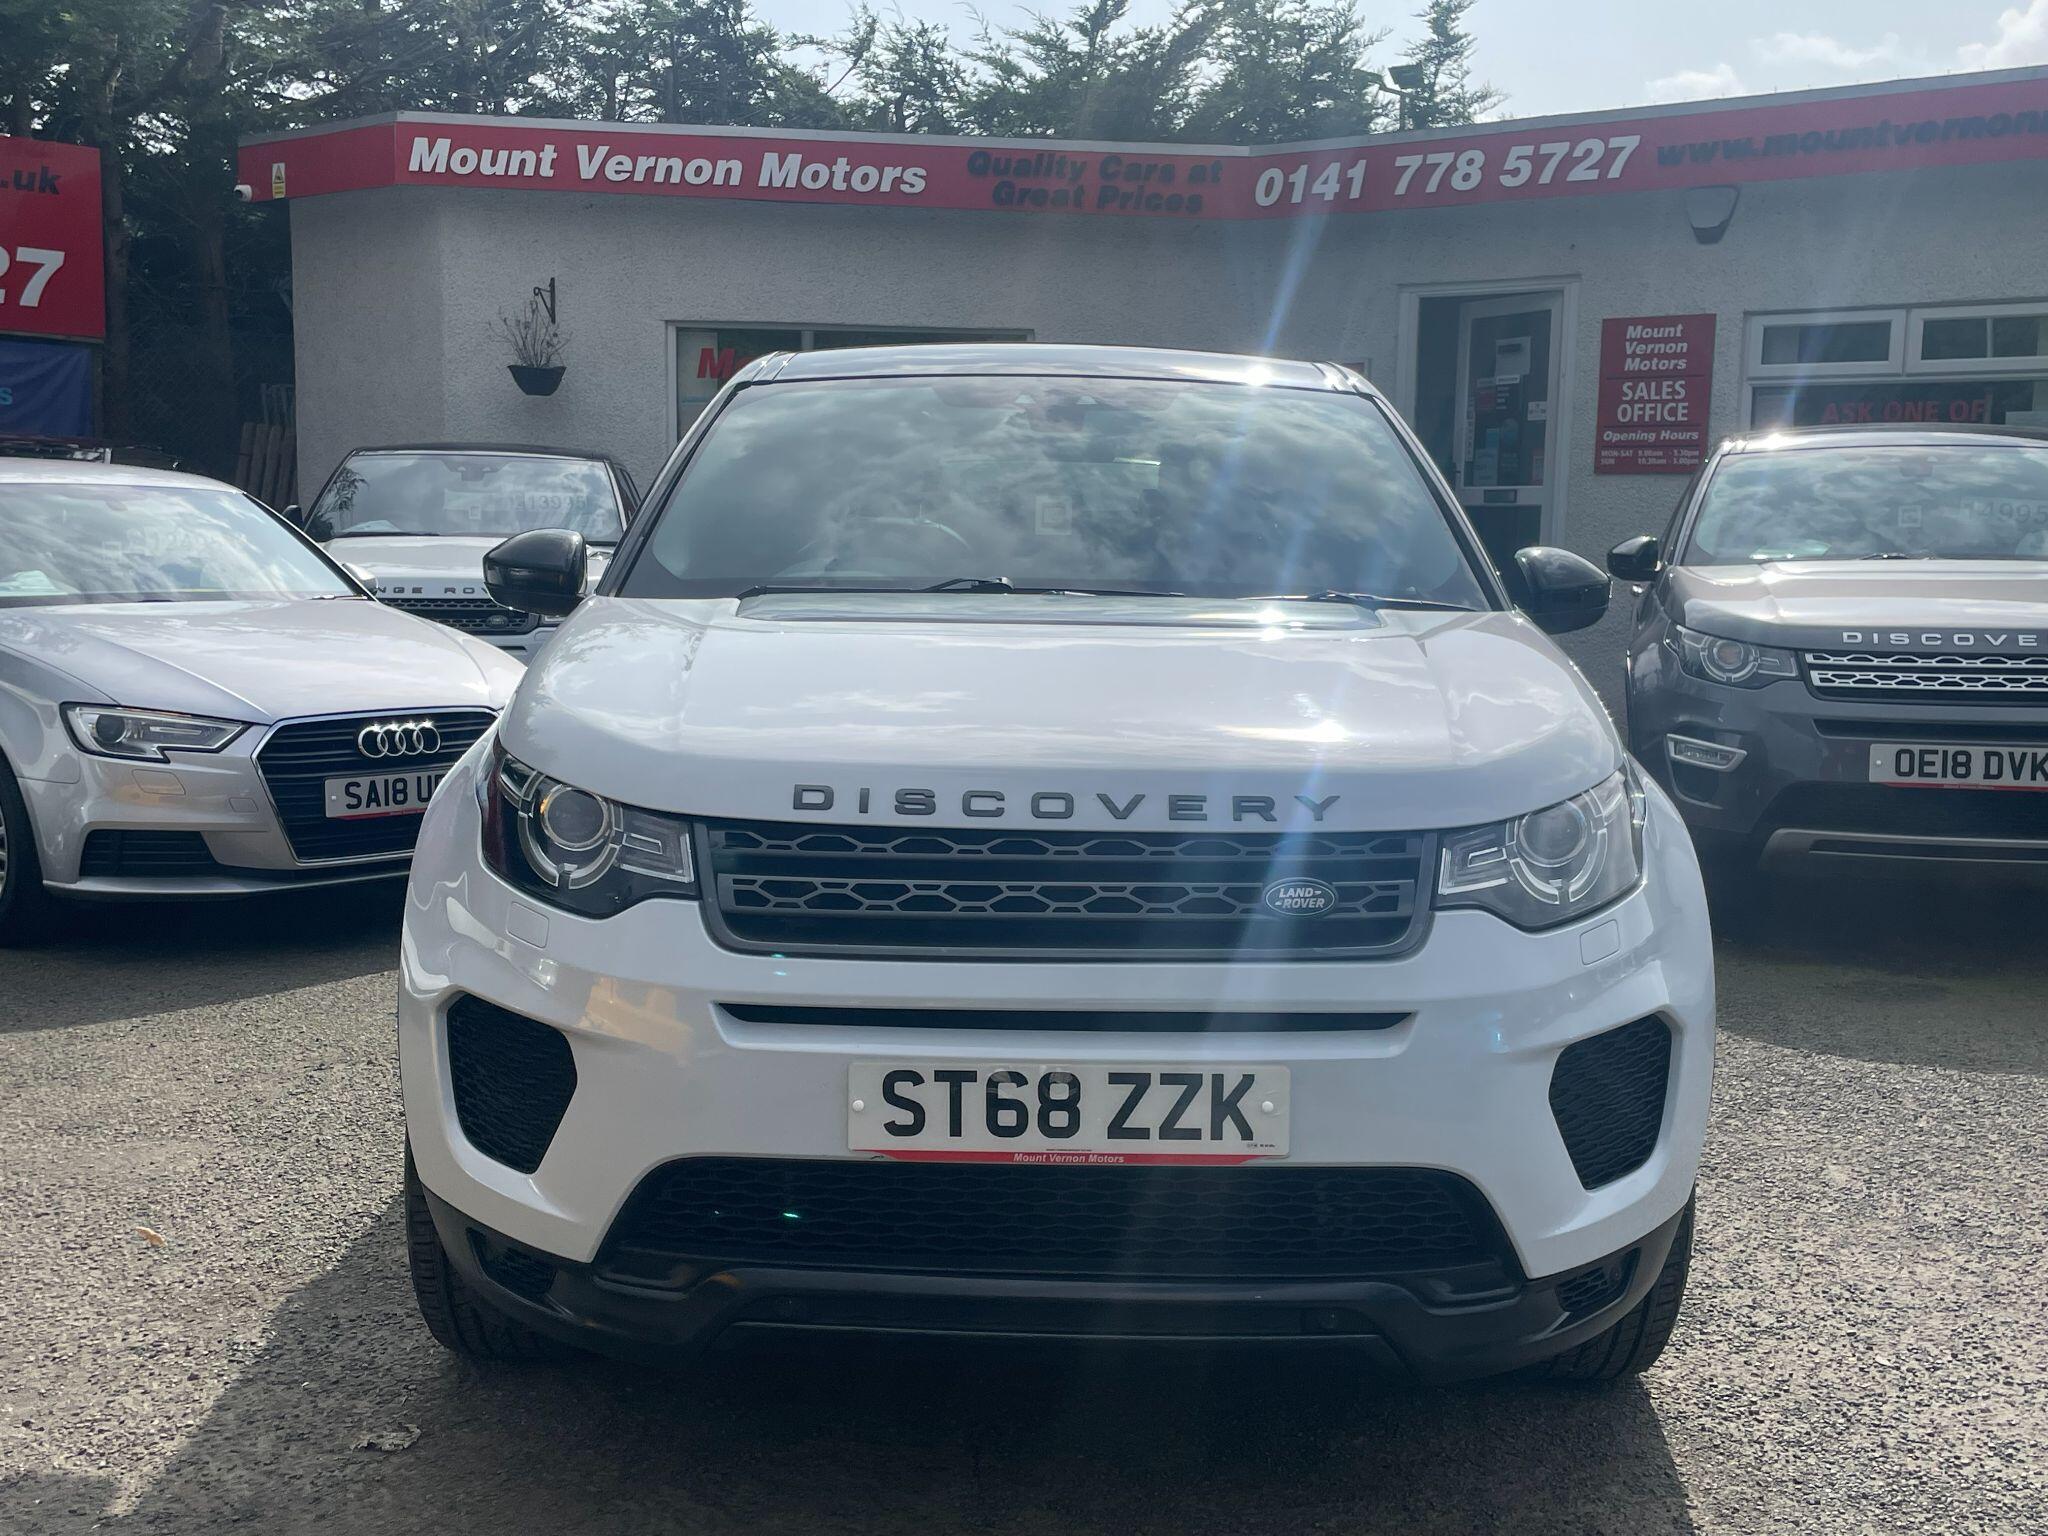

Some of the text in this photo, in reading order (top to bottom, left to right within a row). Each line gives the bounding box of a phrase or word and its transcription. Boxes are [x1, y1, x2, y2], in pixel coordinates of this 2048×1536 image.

[1656, 109, 2048, 167] www.mountvernon
[408, 136, 928, 194] Mount Vernon Motors
[967, 150, 1224, 184] Quality Cars at
[1254, 135, 1641, 207] 0141 778 5727
[992, 180, 1204, 213] Great Prices
[0, 246, 66, 308] 7
[1625, 341, 1688, 355] Vernon
[1626, 323, 1684, 340] Mount
[1623, 357, 1688, 371] Motors
[1622, 380, 1686, 401] SALES
[1616, 402, 1689, 423] OFFICE
[1821, 400, 1874, 424] ASK
[1884, 400, 1940, 422] ONE
[1603, 430, 1699, 443] Opening Hours
[1842, 631, 2038, 647] DISCOVE
[1894, 748, 2048, 782] OE18 DVK
[344, 777, 408, 810] SA18
[792, 784, 1342, 823] DISCOVERY
[881, 1068, 1256, 1141] ST68 ZZK
[1013, 1152, 1125, 1164] Mount Vernon Motors
